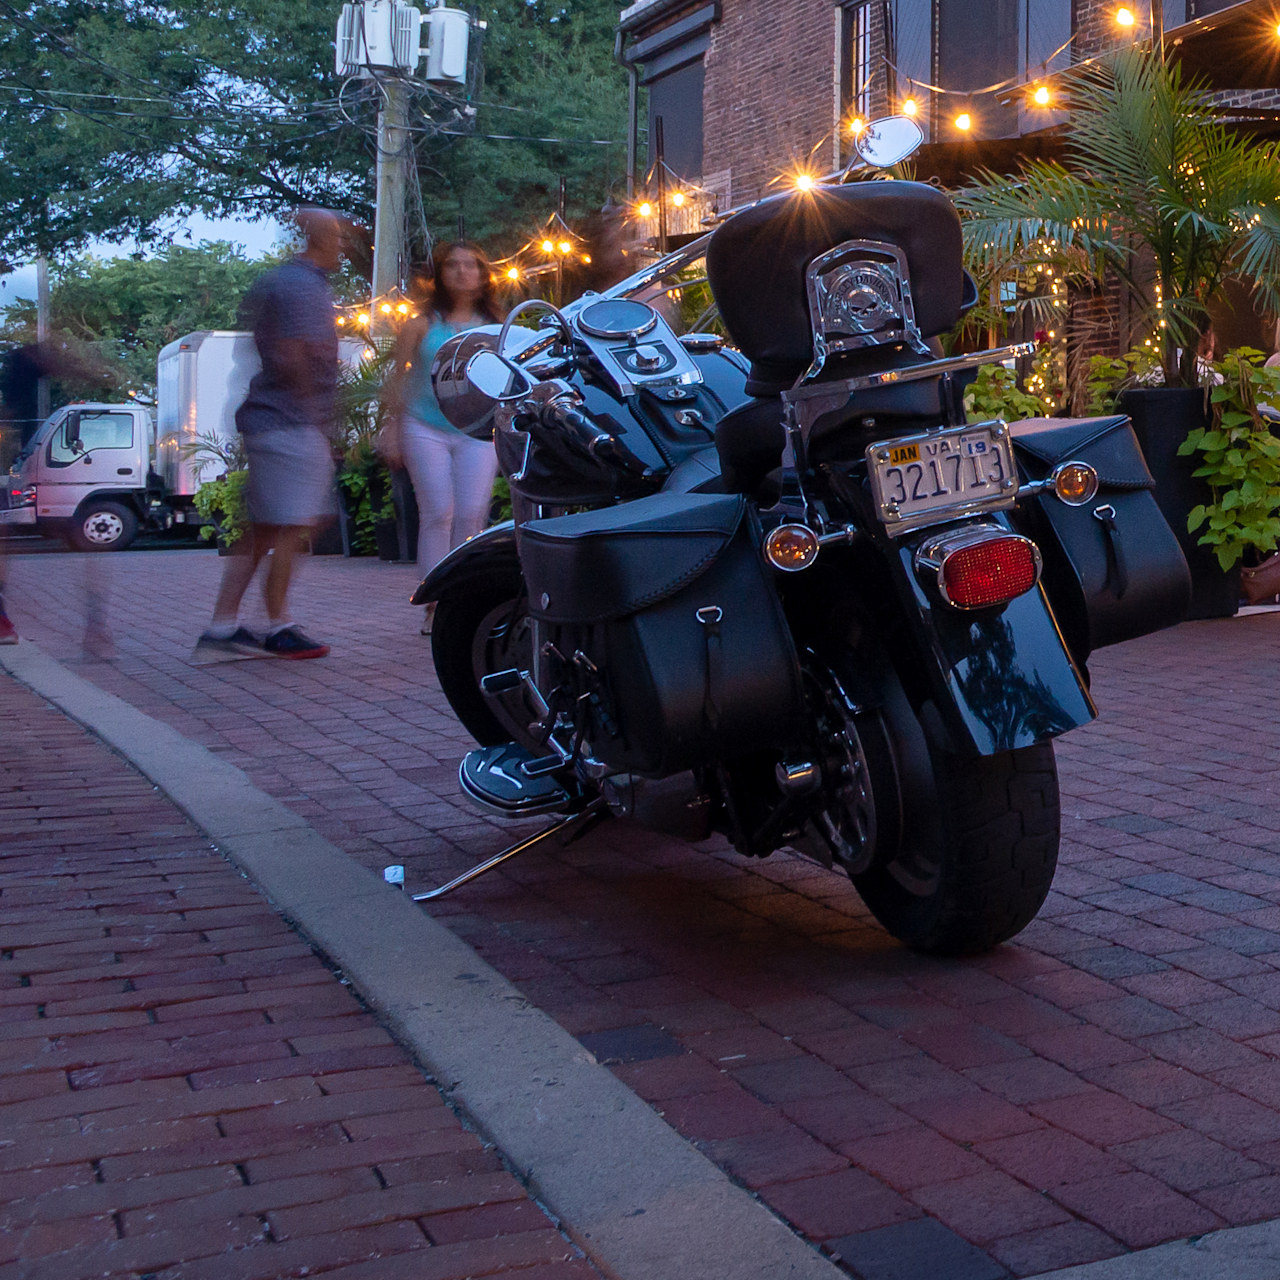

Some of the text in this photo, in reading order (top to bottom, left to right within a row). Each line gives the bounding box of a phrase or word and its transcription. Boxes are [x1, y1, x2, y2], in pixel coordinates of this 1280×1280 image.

[892, 446, 917, 463] JAN
[926, 440, 950, 456] VA
[967, 441, 986, 455] 19
[886, 446, 1004, 505] 321713
